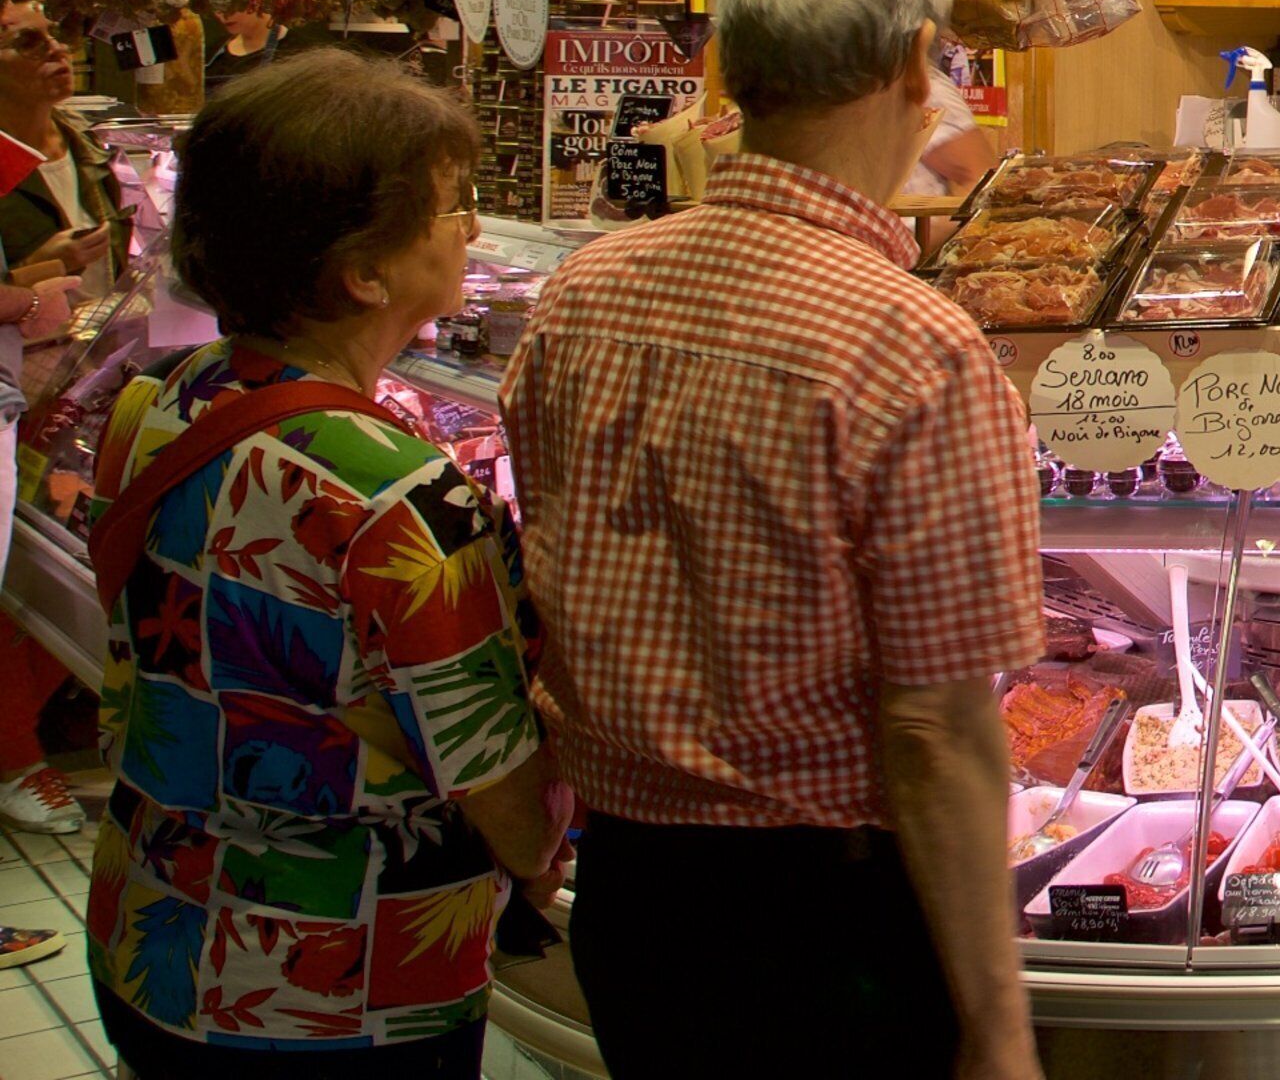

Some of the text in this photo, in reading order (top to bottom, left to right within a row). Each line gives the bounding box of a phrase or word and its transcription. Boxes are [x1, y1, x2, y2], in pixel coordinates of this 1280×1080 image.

[552, 78, 698, 96] LE FIGARO
[1083, 343, 1115, 360] 8,00
[1041, 360, 1149, 388] Serrano
[1057, 391, 1139, 411] 18 mois
[1051, 428, 1088, 441] Noir
